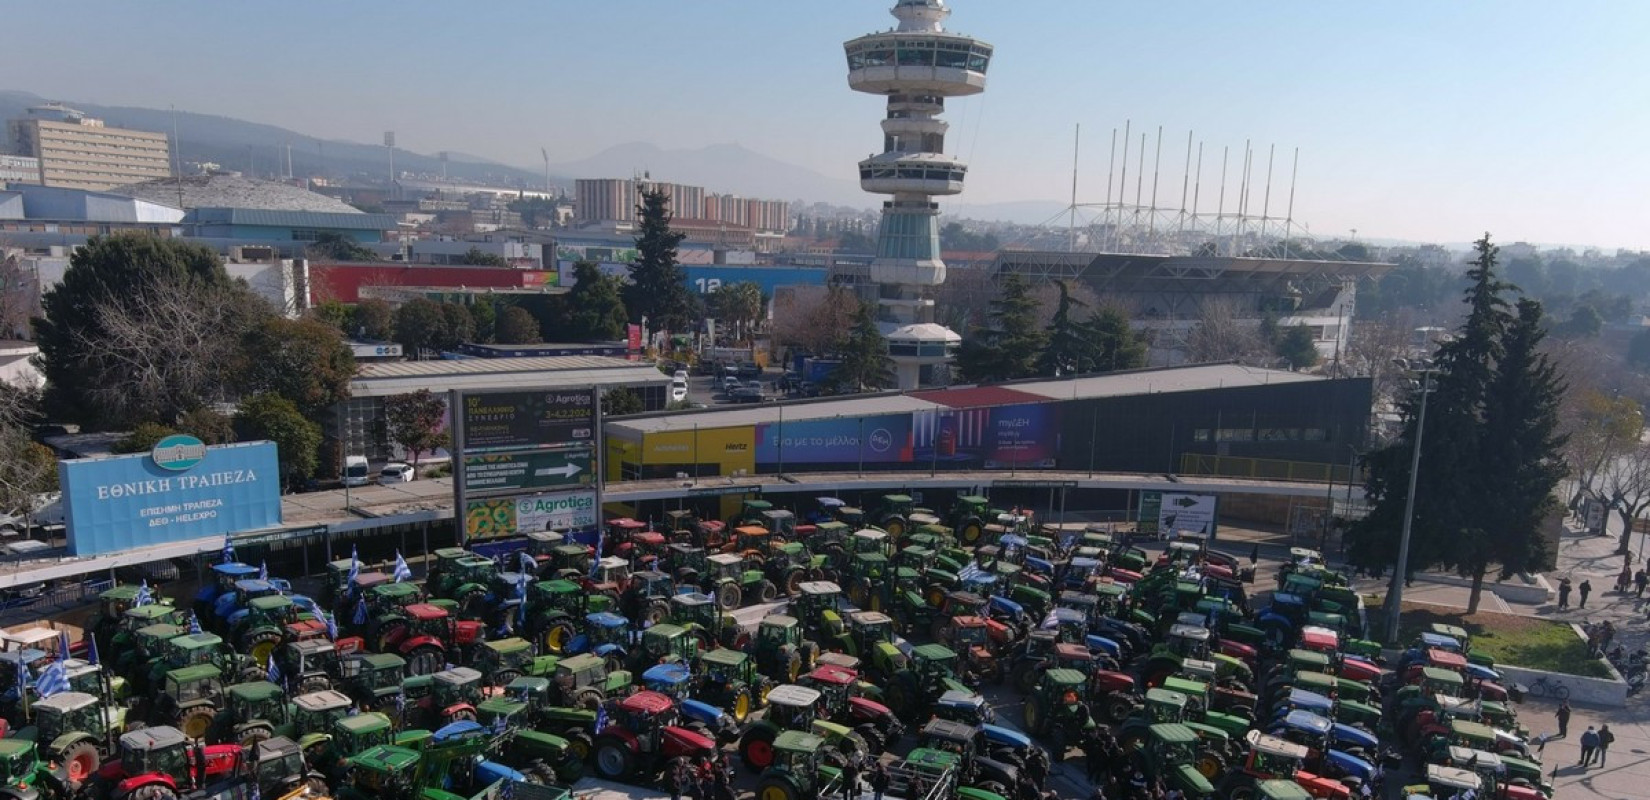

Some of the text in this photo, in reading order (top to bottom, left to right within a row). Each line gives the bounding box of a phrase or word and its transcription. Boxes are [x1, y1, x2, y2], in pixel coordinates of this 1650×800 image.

[695, 278, 721, 294] 12
[556, 394, 591, 404] Agrotica
[725, 443, 747, 451] Hertz
[98, 469, 257, 499] ΕΘΝΙΚΗ ΤΡΑΠΕΖΑ
[140, 499, 223, 517] ΕΠΙΣΗΜΗ ΤΡΑΠΕΖΑ
[535, 496, 592, 512] Agrotica
[149, 517, 169, 527] ΔΕΘ
[175, 510, 217, 523] HELEXPO
